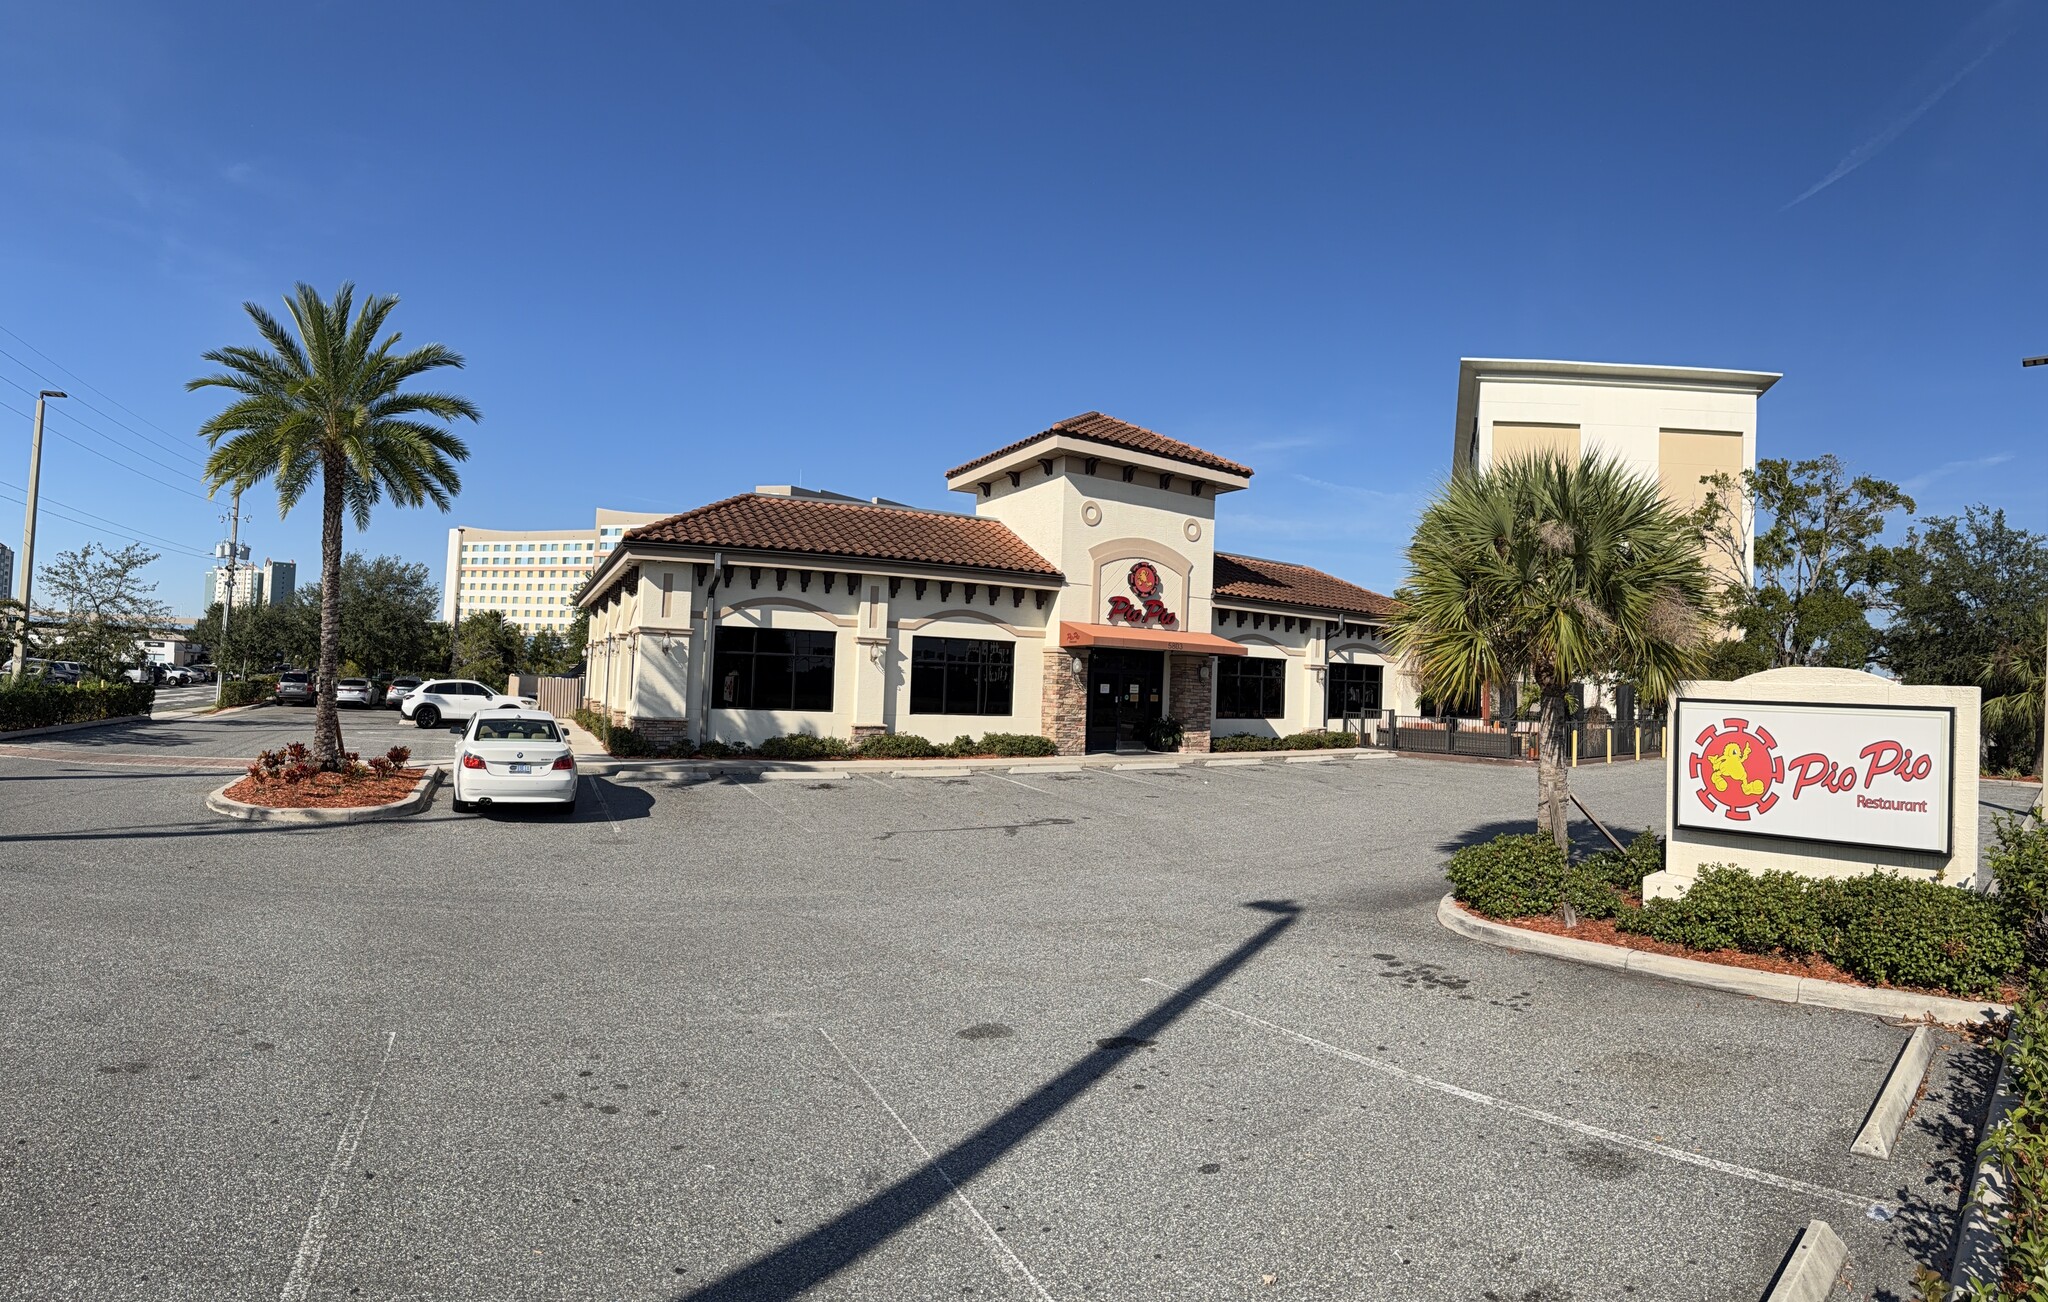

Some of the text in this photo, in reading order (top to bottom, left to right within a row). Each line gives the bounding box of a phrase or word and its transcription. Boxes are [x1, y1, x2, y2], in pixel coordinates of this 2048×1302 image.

[1107, 596, 1176, 625] Pio Pio
[1168, 642, 1183, 650] 5803
[1788, 740, 1932, 800] Pio Pio
[1856, 794, 1928, 813] Restaurant
